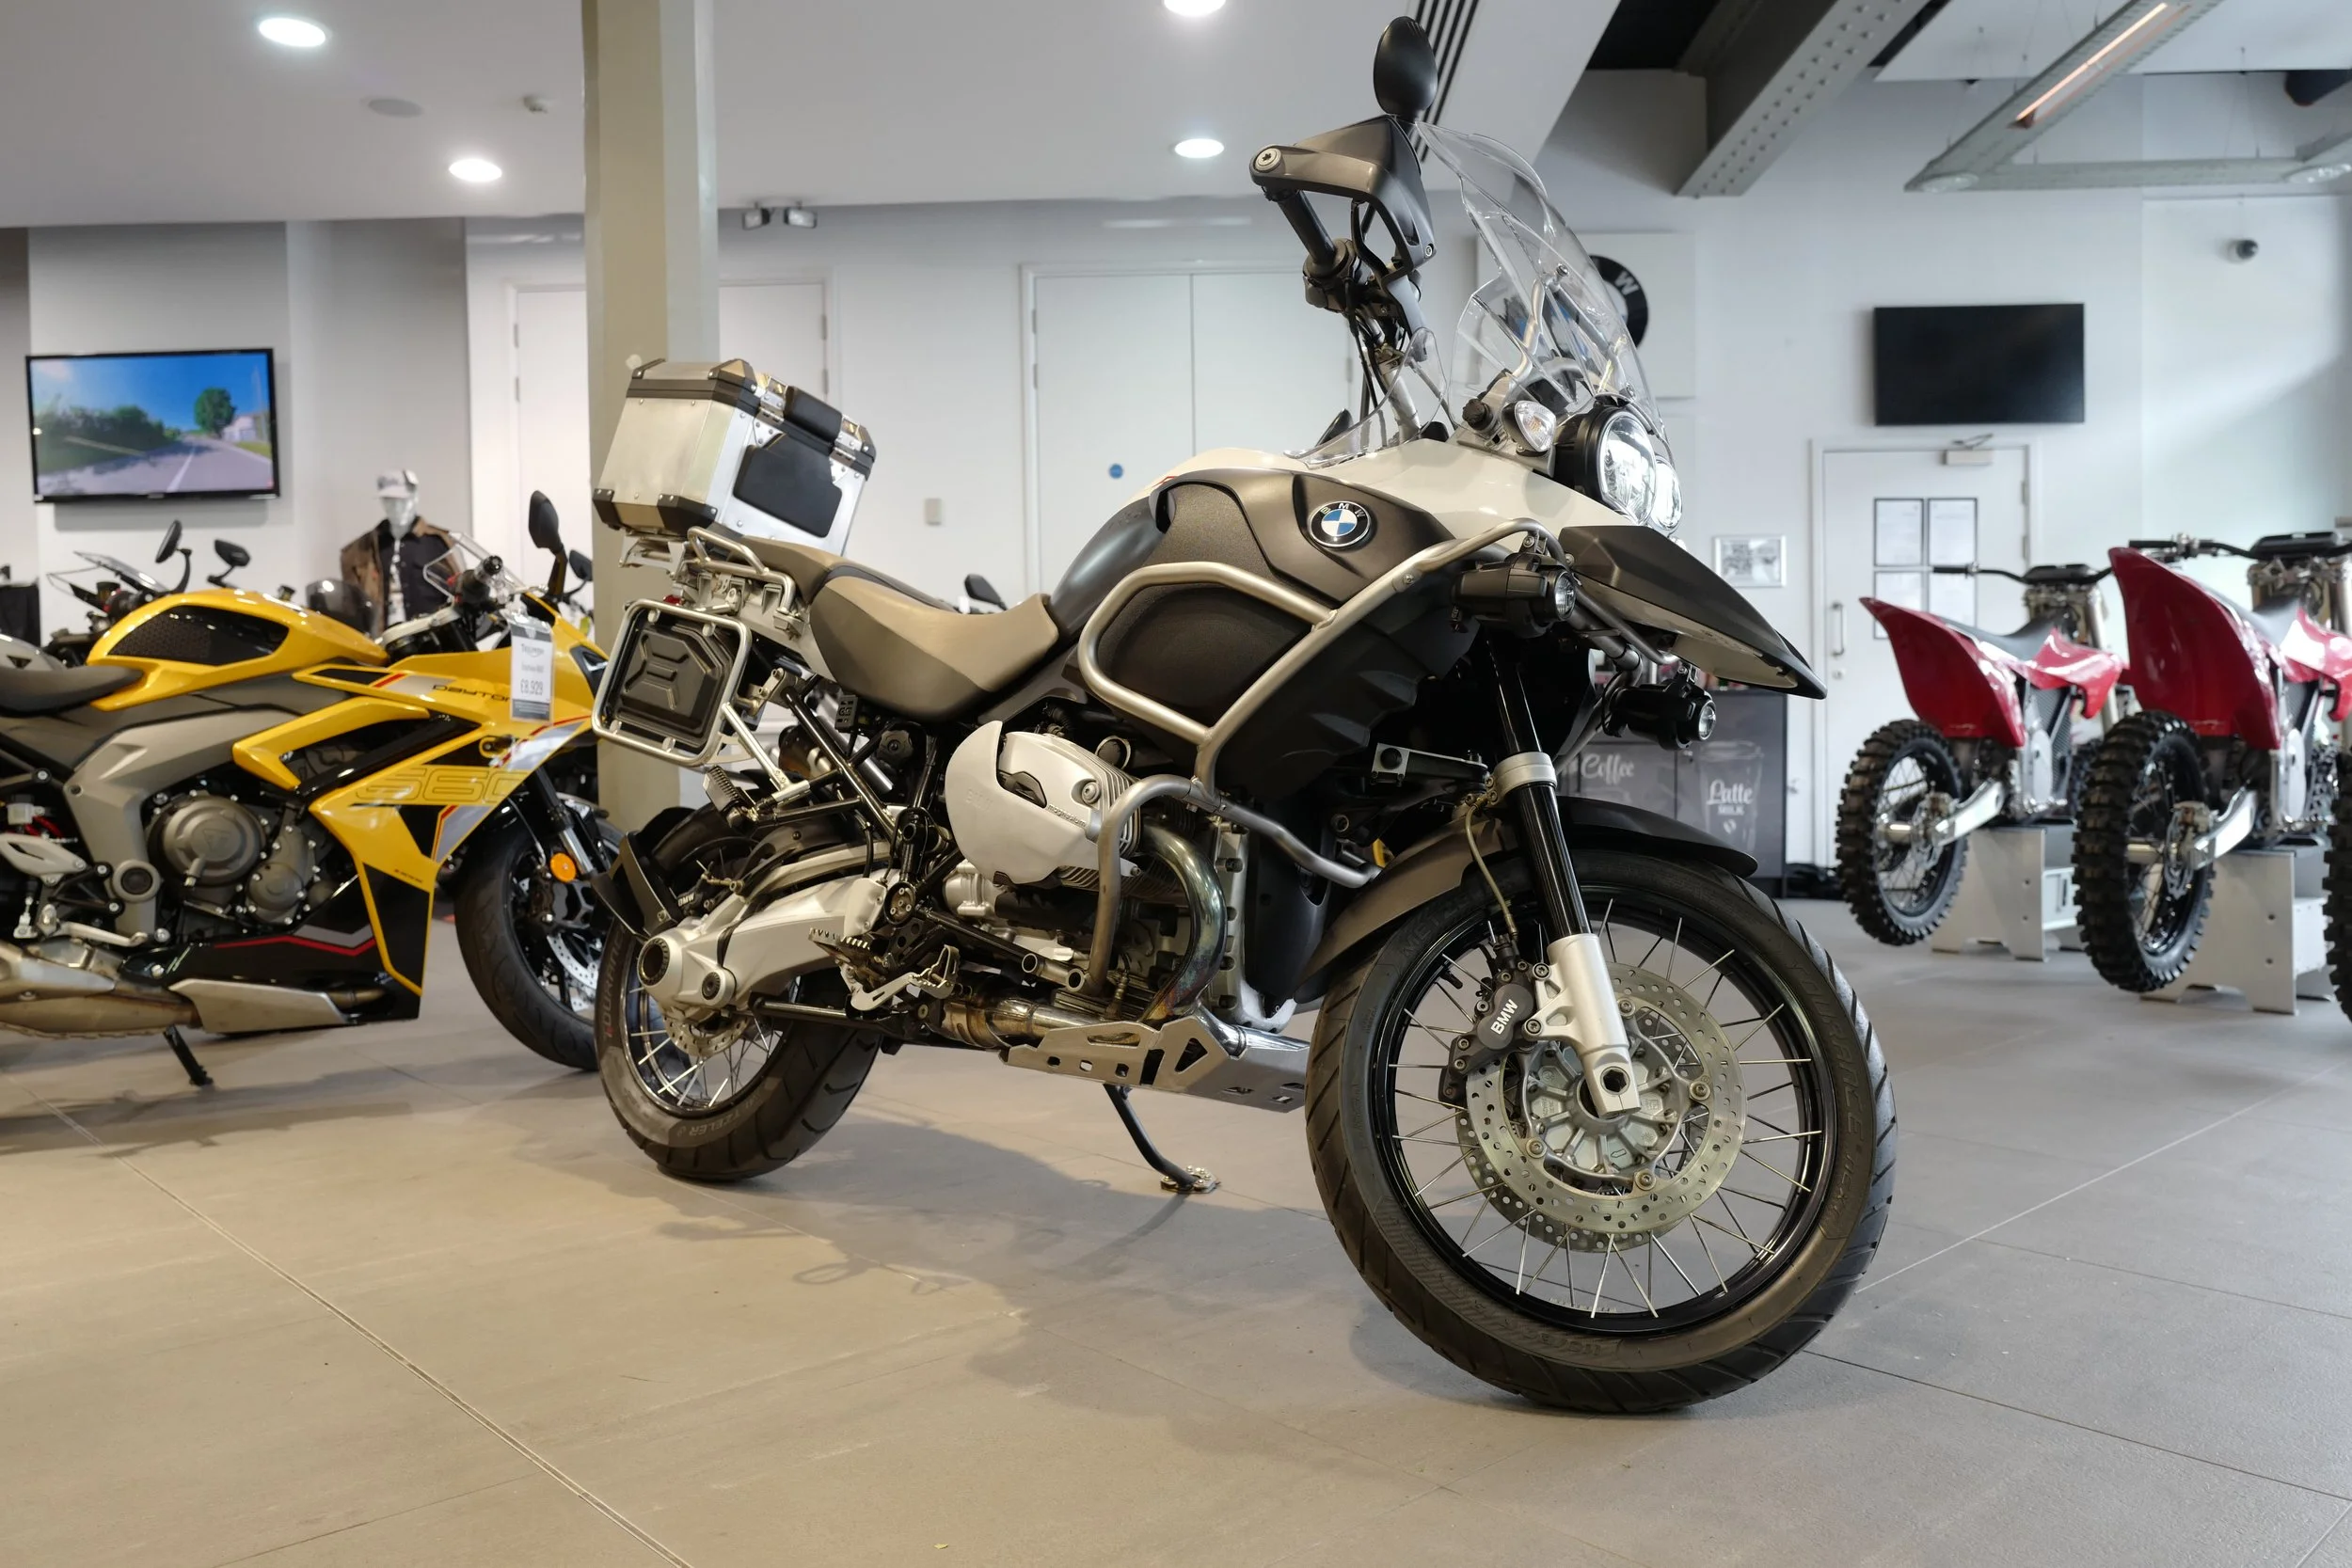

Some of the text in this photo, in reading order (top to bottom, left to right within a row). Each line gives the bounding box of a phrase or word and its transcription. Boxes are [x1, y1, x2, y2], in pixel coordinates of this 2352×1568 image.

[1581, 753, 1635, 784] Coffee
[1706, 779, 1753, 805] Latte
[677, 892, 695, 907] BMW
[1490, 999, 1518, 1035] BMW
